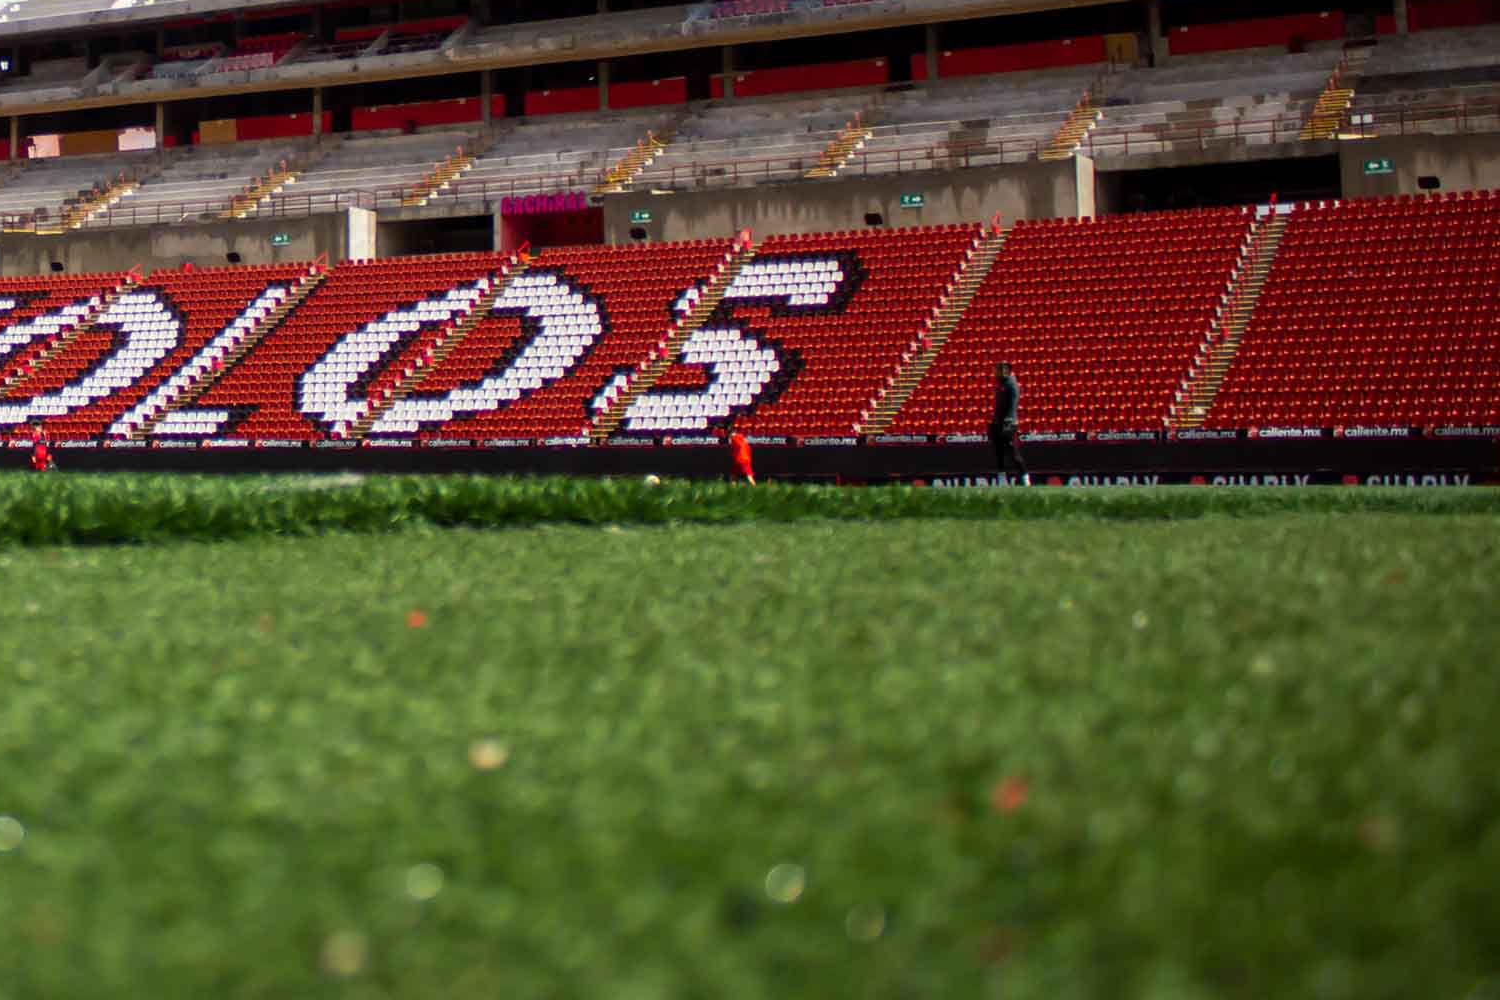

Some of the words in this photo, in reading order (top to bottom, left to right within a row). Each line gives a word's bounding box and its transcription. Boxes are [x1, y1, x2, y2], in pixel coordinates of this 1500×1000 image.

[1019, 431, 1076, 441] caliente.mx
[1098, 431, 1155, 441] caliente.mx
[1178, 428, 1236, 440] caliente.mx
[1259, 426, 1321, 437] caliente.mx
[1344, 425, 1409, 437] caliente.mx
